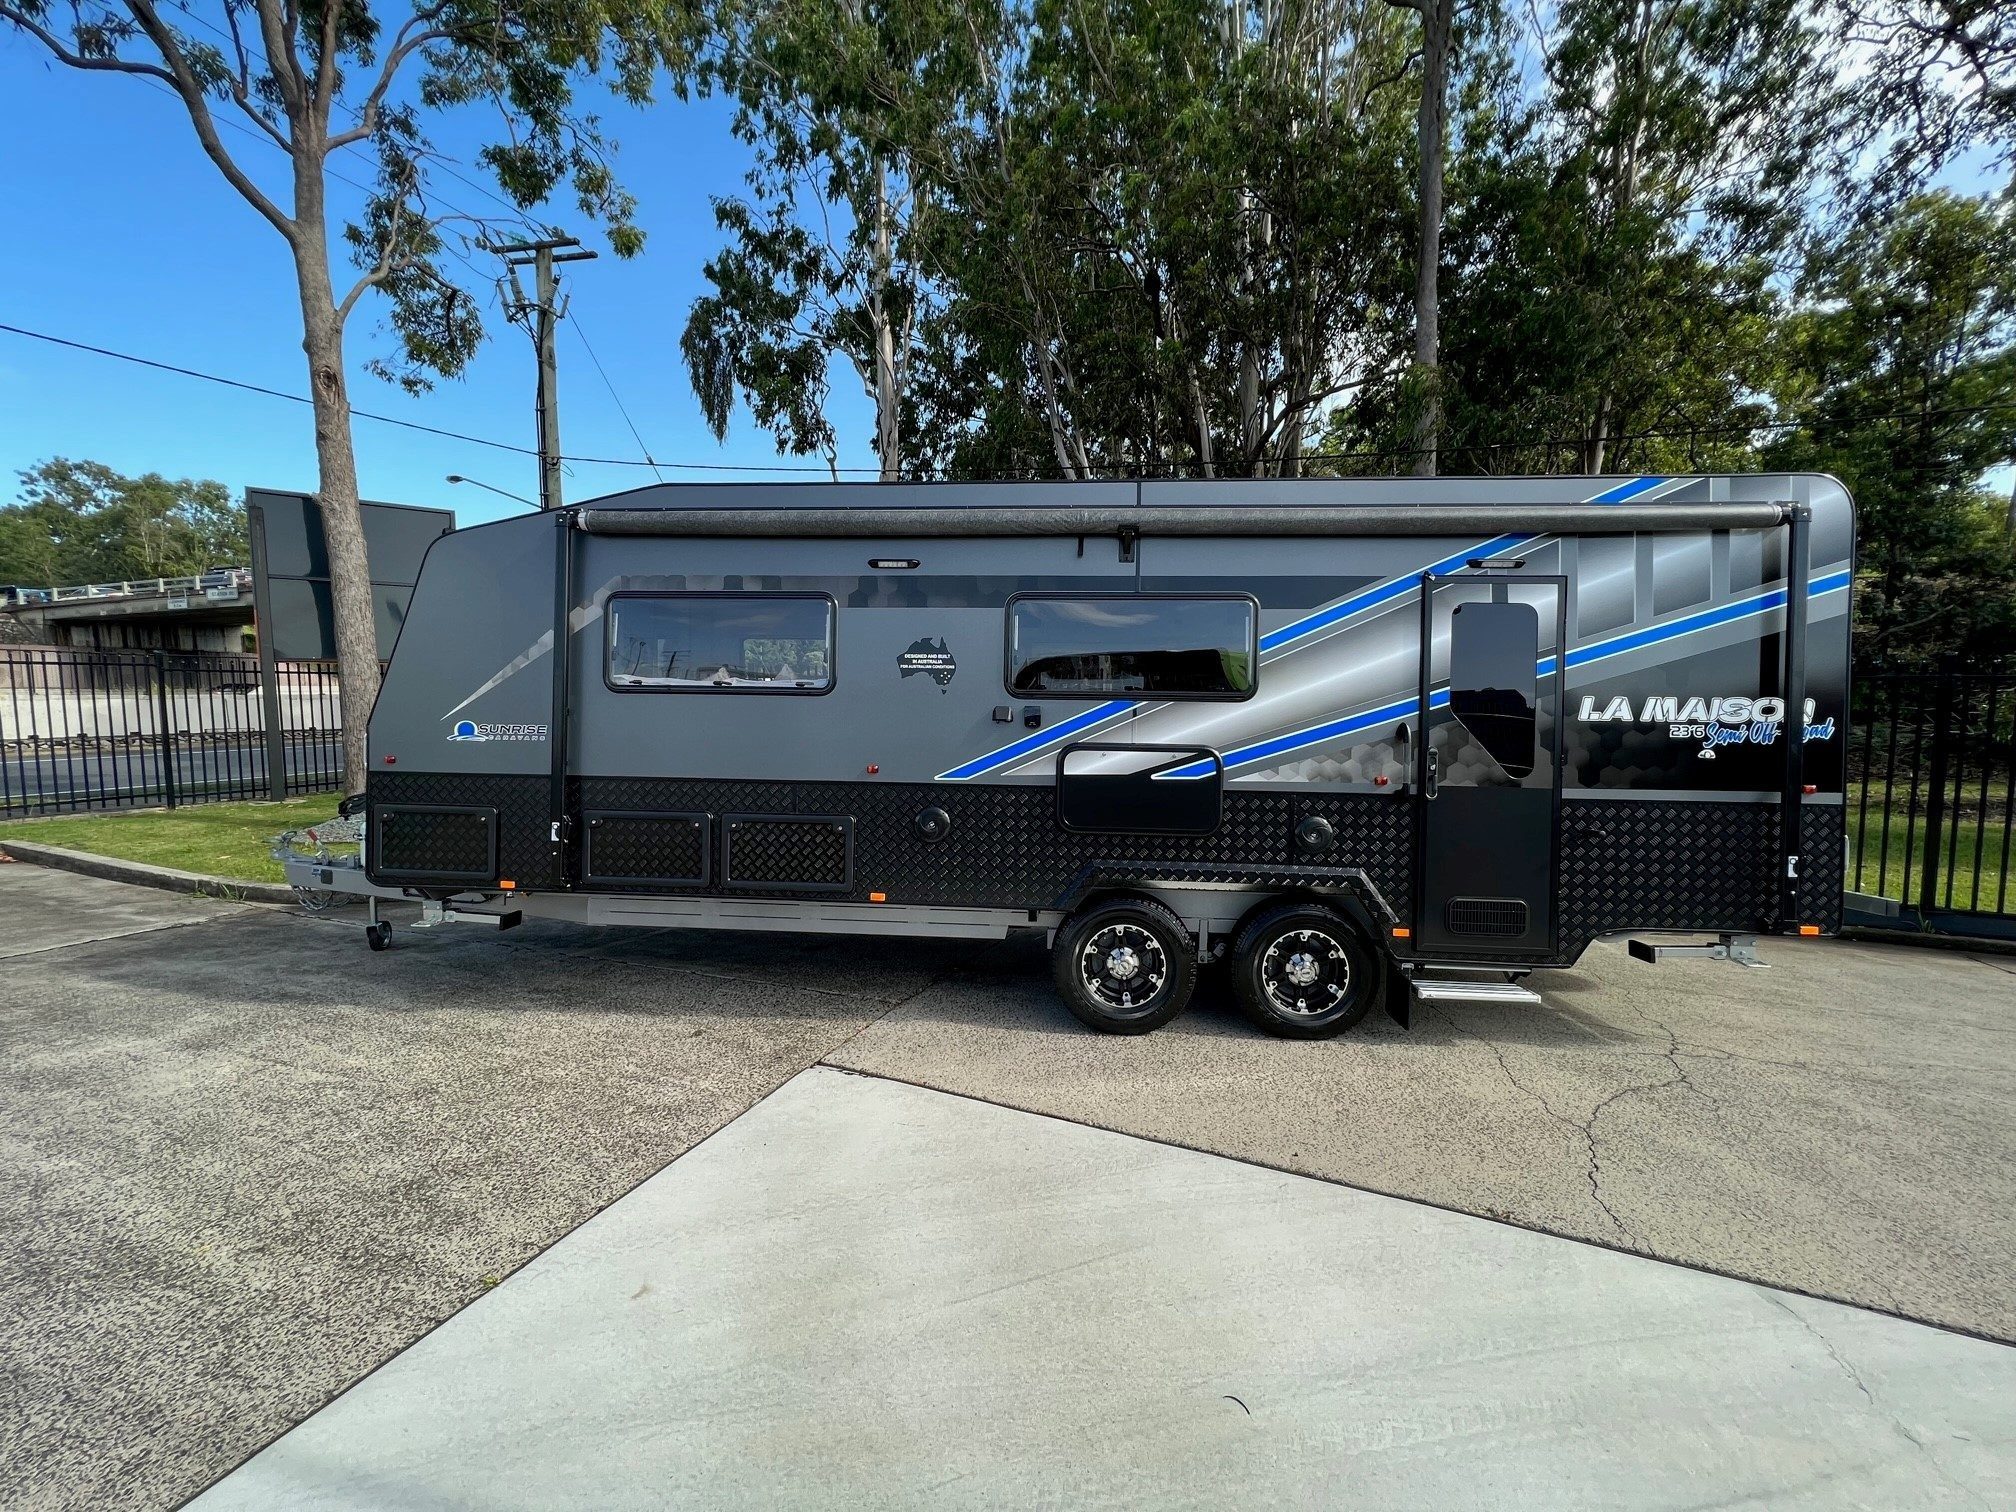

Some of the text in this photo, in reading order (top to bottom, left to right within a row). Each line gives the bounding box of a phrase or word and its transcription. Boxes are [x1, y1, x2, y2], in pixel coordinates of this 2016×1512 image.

[1577, 696, 1634, 722] LA
[478, 724, 548, 735] SUNRISE
[1703, 721, 1749, 748] Semi
